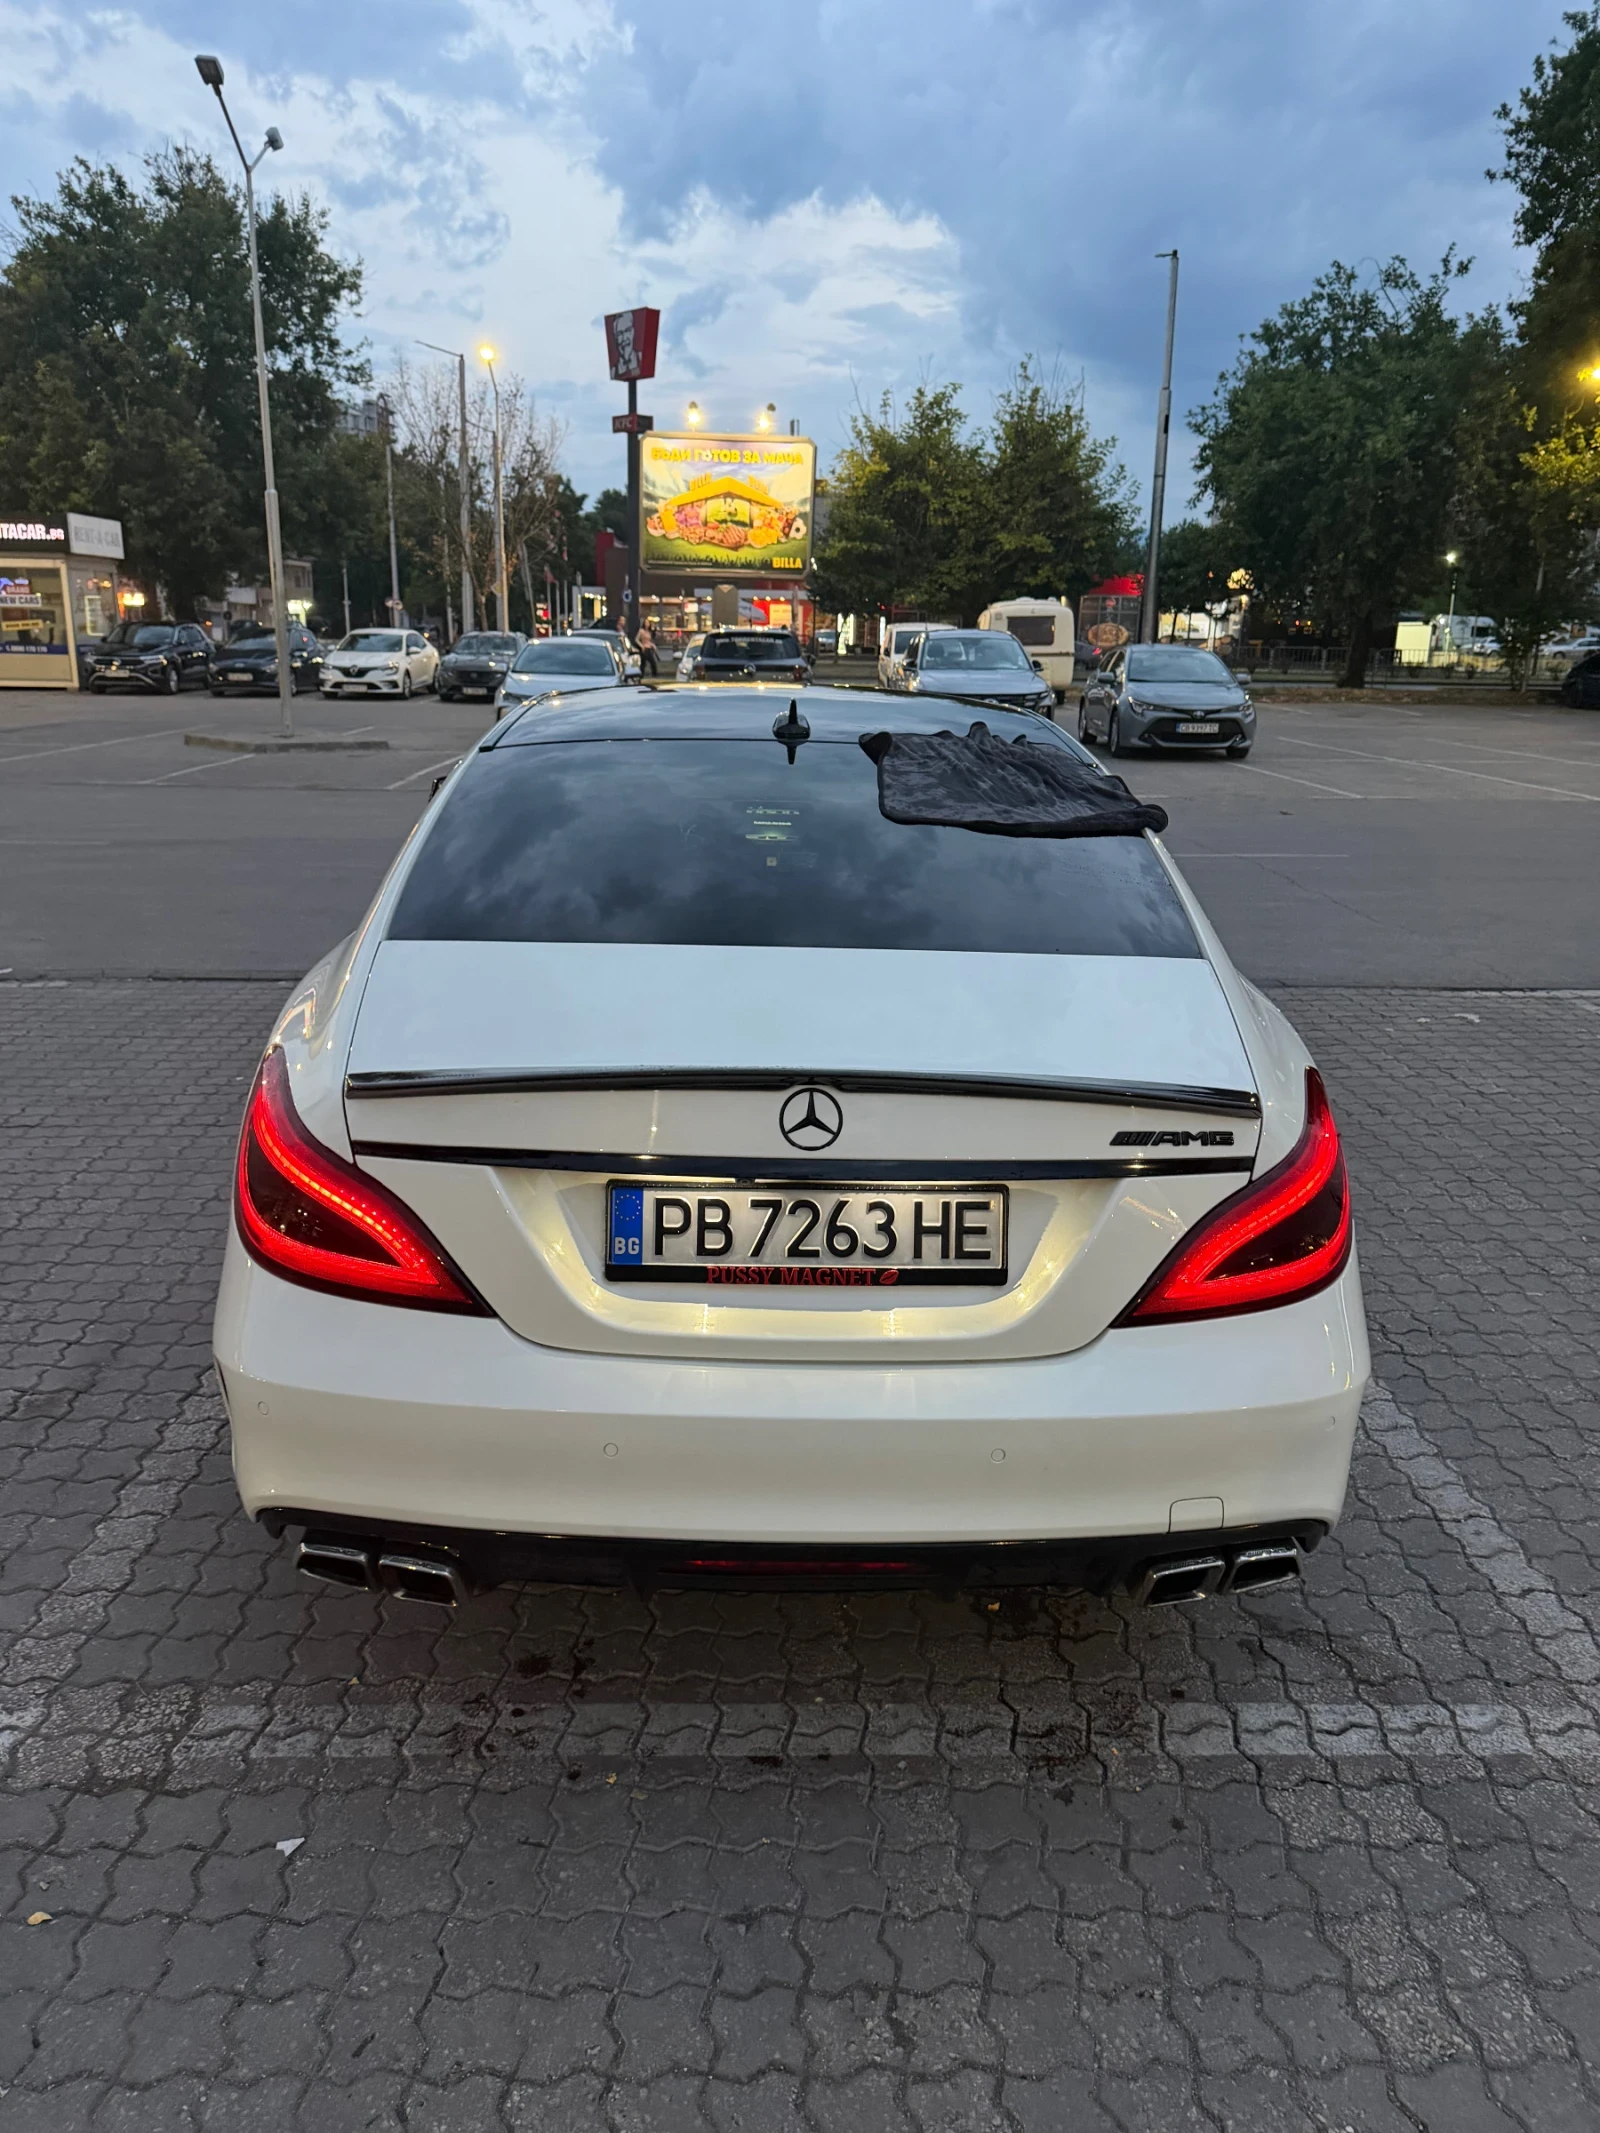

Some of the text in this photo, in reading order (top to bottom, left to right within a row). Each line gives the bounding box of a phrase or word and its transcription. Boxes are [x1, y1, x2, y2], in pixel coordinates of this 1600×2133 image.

[614, 416, 633, 430] KFC
[651, 447, 804, 465] БЪДИ ГОТОВ ЗА МАЧА
[772, 557, 803, 569] BILLA
[1151, 1131, 1235, 1146] AMG
[655, 1197, 992, 1260] PB 7263 HE
[614, 1237, 640, 1255] BG
[707, 1266, 877, 1286] PUSSY MAGNET
